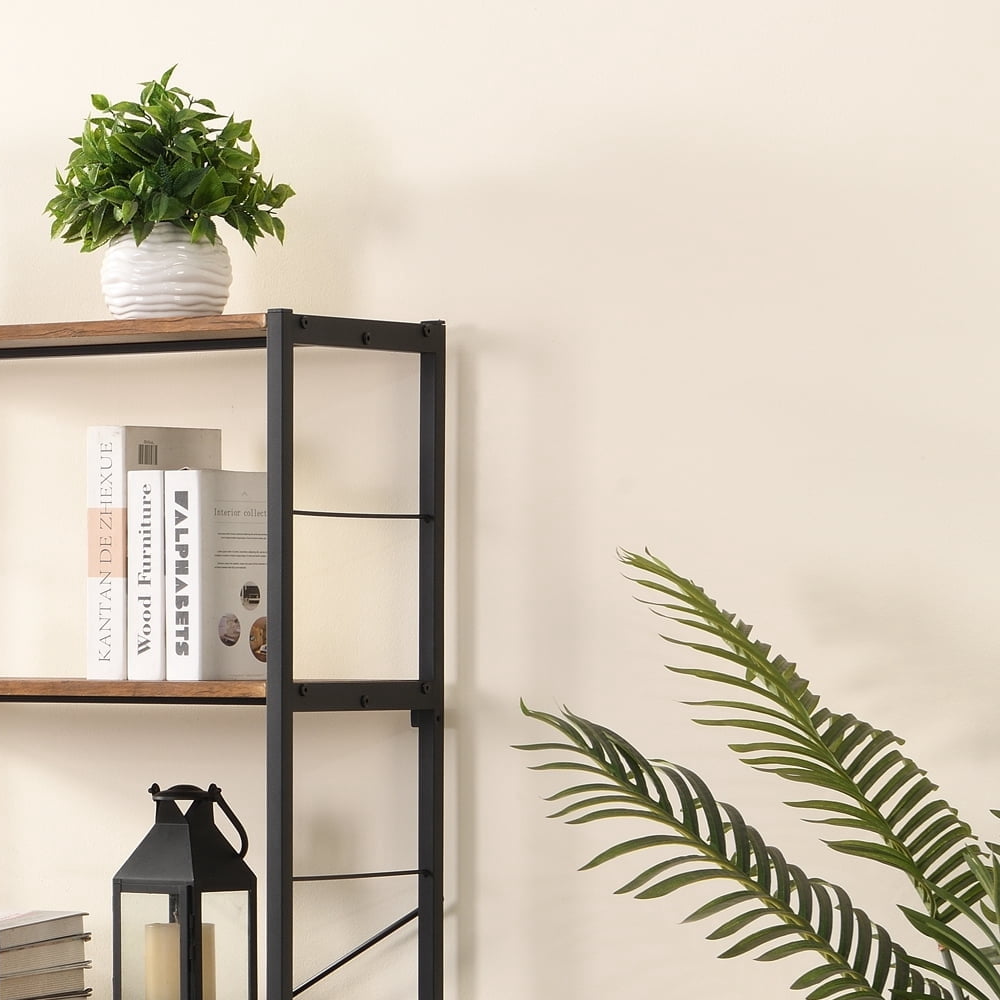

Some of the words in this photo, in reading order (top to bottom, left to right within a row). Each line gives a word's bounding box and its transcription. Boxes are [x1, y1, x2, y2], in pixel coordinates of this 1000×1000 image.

[100, 441, 113, 530] ZHEXUE
[213, 507, 241, 517] Interior
[100, 535, 112, 563] DE
[137, 482, 152, 587] Furniture
[98, 571, 112, 661] KANTAN
[137, 596, 152, 656] Wood
